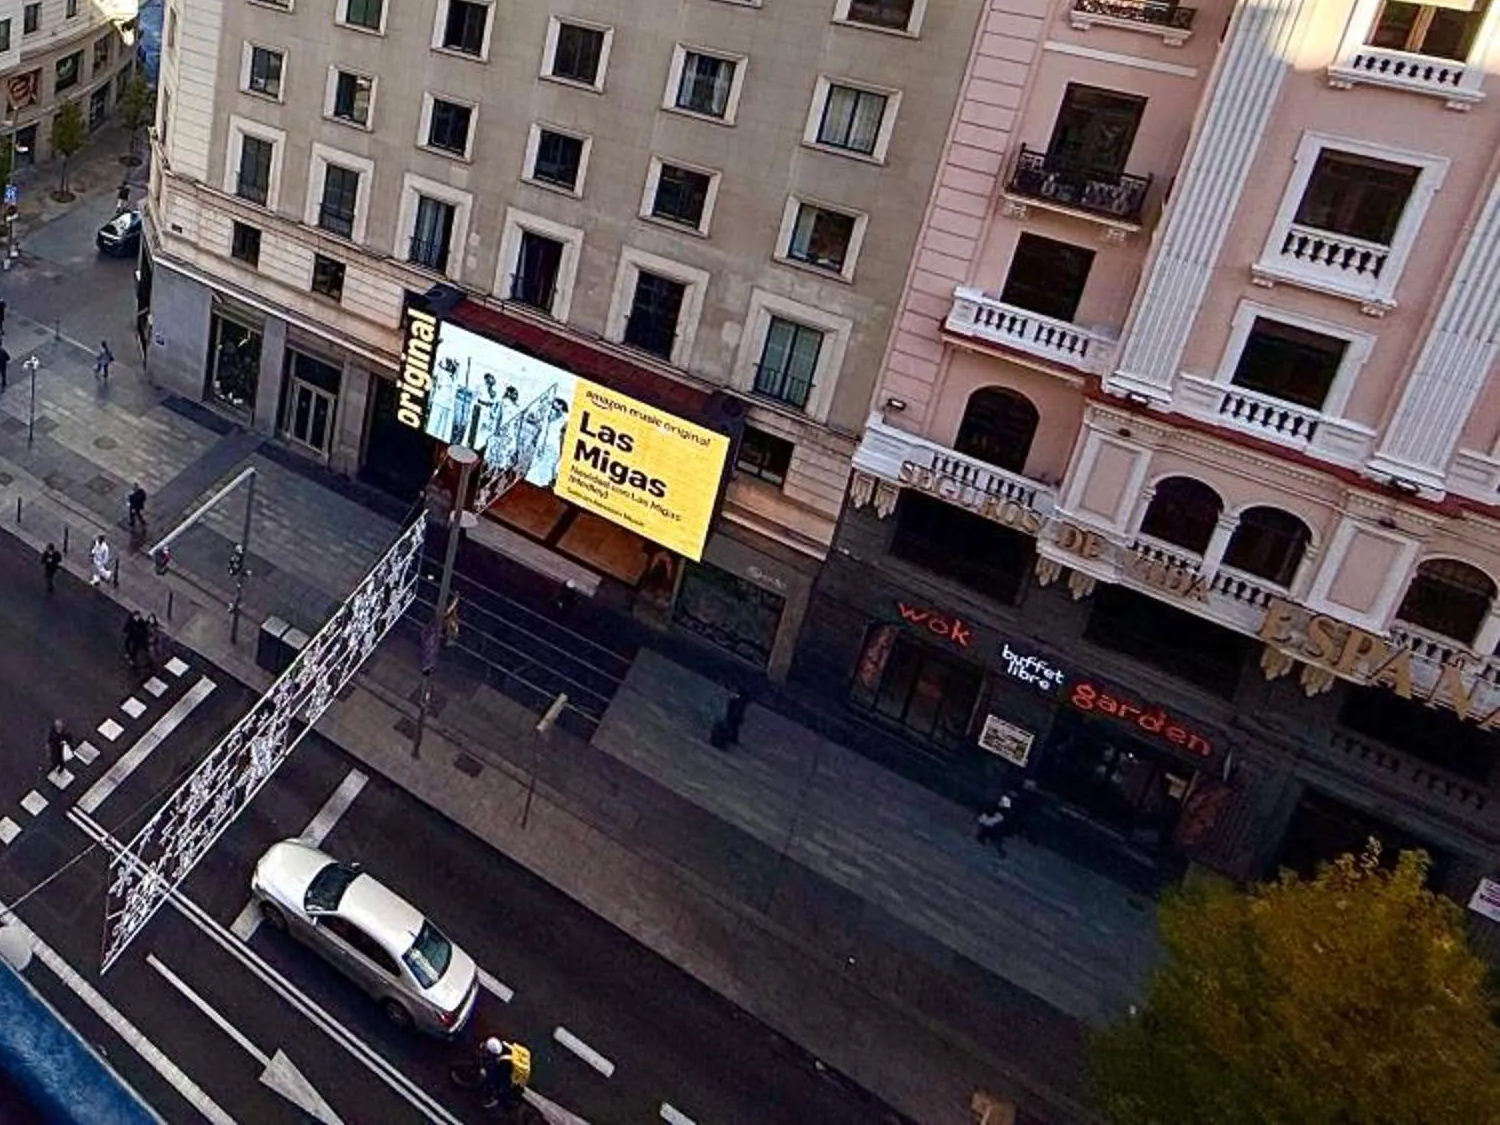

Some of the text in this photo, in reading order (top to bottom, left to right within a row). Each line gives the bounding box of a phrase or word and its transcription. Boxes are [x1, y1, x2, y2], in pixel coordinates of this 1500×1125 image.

[396, 307, 437, 429] original
[579, 410, 635, 453] Las
[585, 389, 711, 448] amazon music original
[573, 438, 667, 499] Migas
[898, 602, 971, 646] wok
[1057, 520, 1106, 559] DE
[1257, 596, 1500, 734] ESPAÑ
[1001, 643, 1065, 685] buffet
[1007, 659, 1051, 690] libre
[1071, 683, 1212, 757] garden
